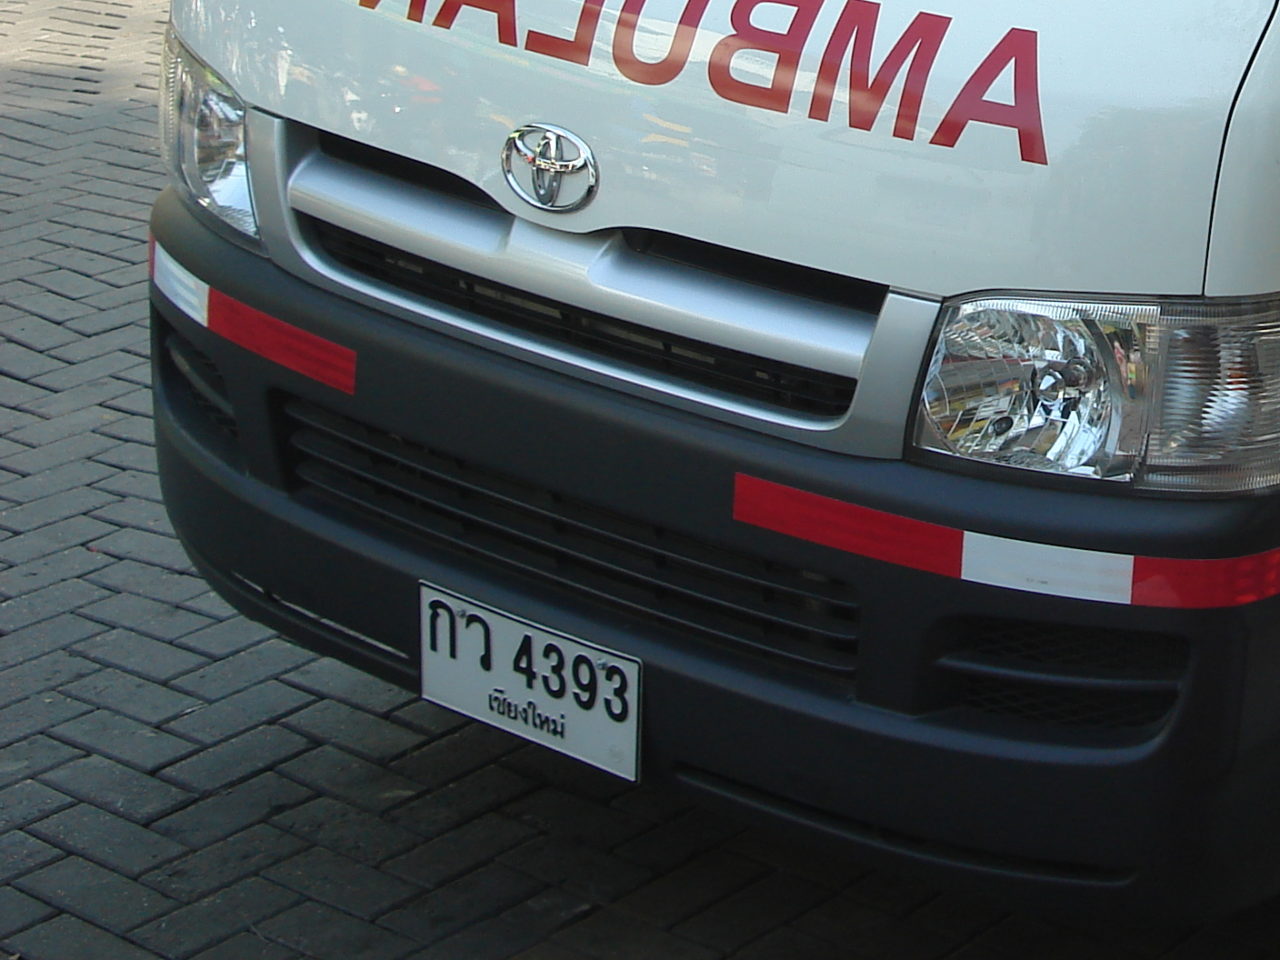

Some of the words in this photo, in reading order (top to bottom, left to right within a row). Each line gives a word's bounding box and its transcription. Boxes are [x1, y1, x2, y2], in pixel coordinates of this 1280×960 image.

[428, 599, 492, 672] กว
[513, 633, 629, 724] 4393
[488, 687, 567, 740] เชียงใหม่
